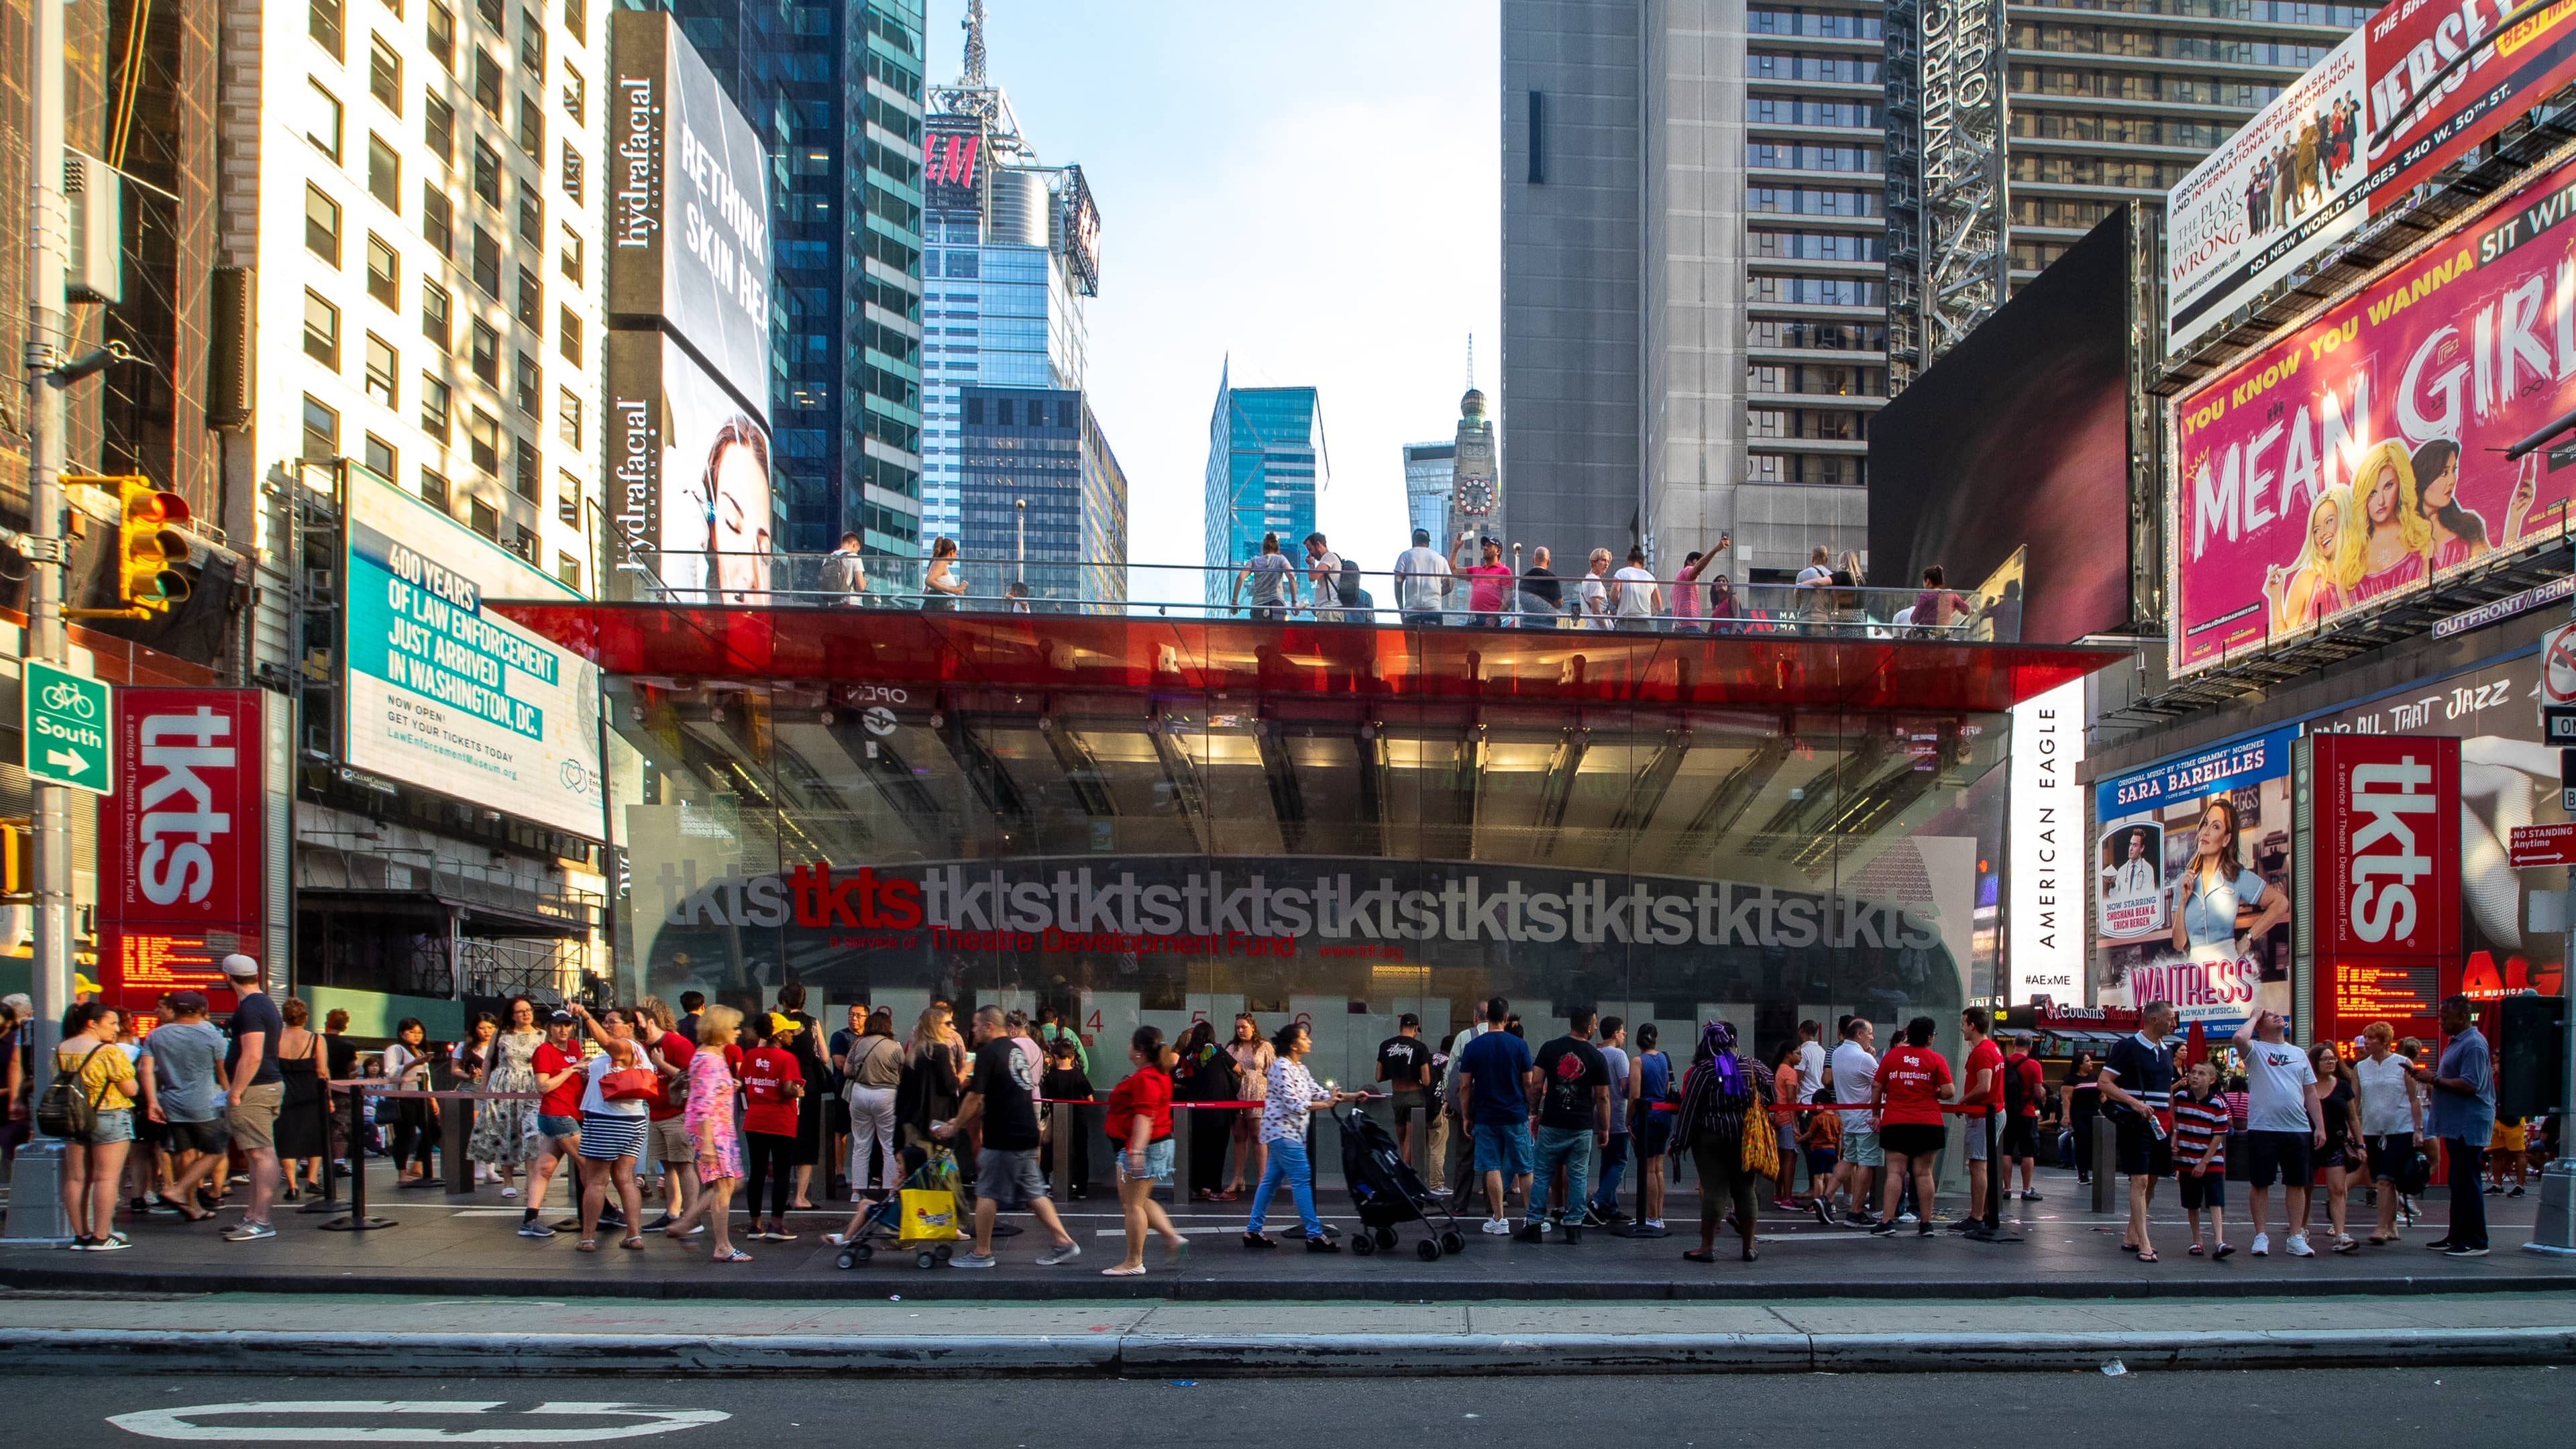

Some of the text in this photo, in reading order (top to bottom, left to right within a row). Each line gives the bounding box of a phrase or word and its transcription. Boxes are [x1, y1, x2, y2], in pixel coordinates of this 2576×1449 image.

[2373, 10, 2398, 43] THE
[2171, 60, 2355, 219] AND INTERNATIONAL PHENOMENON
[2175, 50, 2349, 203] BROADWAY'S FUNNIEST SMASH HIT
[619, 76, 659, 249] hydrafacial
[652, 125, 660, 209] COMPANY
[2269, 235, 2296, 259] NEW
[2300, 201, 2345, 237] WORLD
[2348, 163, 2397, 205] STAGES
[2404, 140, 2430, 167] 340
[2434, 127, 2451, 144] W.
[2455, 102, 2486, 131] 50TH
[2489, 81, 2512, 107] ST.
[682, 121, 765, 267] RETHINK
[2177, 180, 2236, 240] THE PLAY
[686, 201, 734, 295] SKIN
[2171, 219, 2244, 283] WRONG
[2172, 195, 2243, 260] THAT GOES
[2185, 400, 2225, 435] YOU
[2233, 349, 2302, 409] KNOW
[2308, 315, 2359, 362] YOU
[2367, 248, 2473, 327] WANNA
[2481, 218, 2520, 263] SIT
[649, 448, 657, 531] COMPANY
[2191, 370, 2369, 564] MEAN
[388, 543, 475, 612] 400 YEARS
[388, 578, 553, 680] OF LAW ENFORCEMENT
[2436, 594, 2525, 636] OUTFRONT
[388, 616, 498, 688] JUST ARRIVED
[388, 649, 538, 735] IN WASHINGTON, DC.
[388, 694, 445, 724] NOW OPEN!
[2357, 714, 2387, 735] ALL
[2388, 695, 2442, 733] THAT
[2445, 678, 2511, 720] JAZZ
[36, 715, 102, 749] South
[127, 723, 135, 759] service
[388, 711, 515, 763] GET YOUR TICKETS TODAY
[126, 761, 136, 771] of
[2117, 749, 2265, 805] SARA BAREILLES
[2118, 775, 2146, 787] ORIGINAL
[2147, 768, 2165, 780] MUSIC
[2167, 765, 2175, 774] BY
[2232, 739, 2265, 755] NOMINEE
[126, 772, 136, 811] Theatre
[140, 706, 235, 906] tkts
[2339, 808, 2347, 816] of
[125, 814, 136, 875] Development
[2039, 708, 2055, 949] AMERICAN EAGLE
[2339, 818, 2347, 854] Theatre
[2351, 755, 2436, 943] tkts
[2514, 826, 2573, 839] NO STANDING
[2514, 839, 2551, 849] Anytime
[126, 879, 136, 904] Fund
[2106, 896, 2157, 911] NOW STARRING
[2338, 857, 2347, 916] Development
[2106, 905, 2156, 922] SHOSHANA BEAN &
[2114, 916, 2150, 930] ERICH BERGEN
[2339, 918, 2347, 941] Fund
[926, 924, 1033, 952] Theatre
[1042, 926, 1220, 961] Development
[1228, 931, 1295, 957] Fund
[2025, 975, 2071, 985] #AExME
[2130, 955, 2253, 1008] WAITRESS
[2483, 987, 2529, 997] MUSICA
[1086, 1009, 1106, 1034] 4
[2208, 1006, 2242, 1015] MUSICAL
[2269, 1053, 2289, 1063] NIKE
